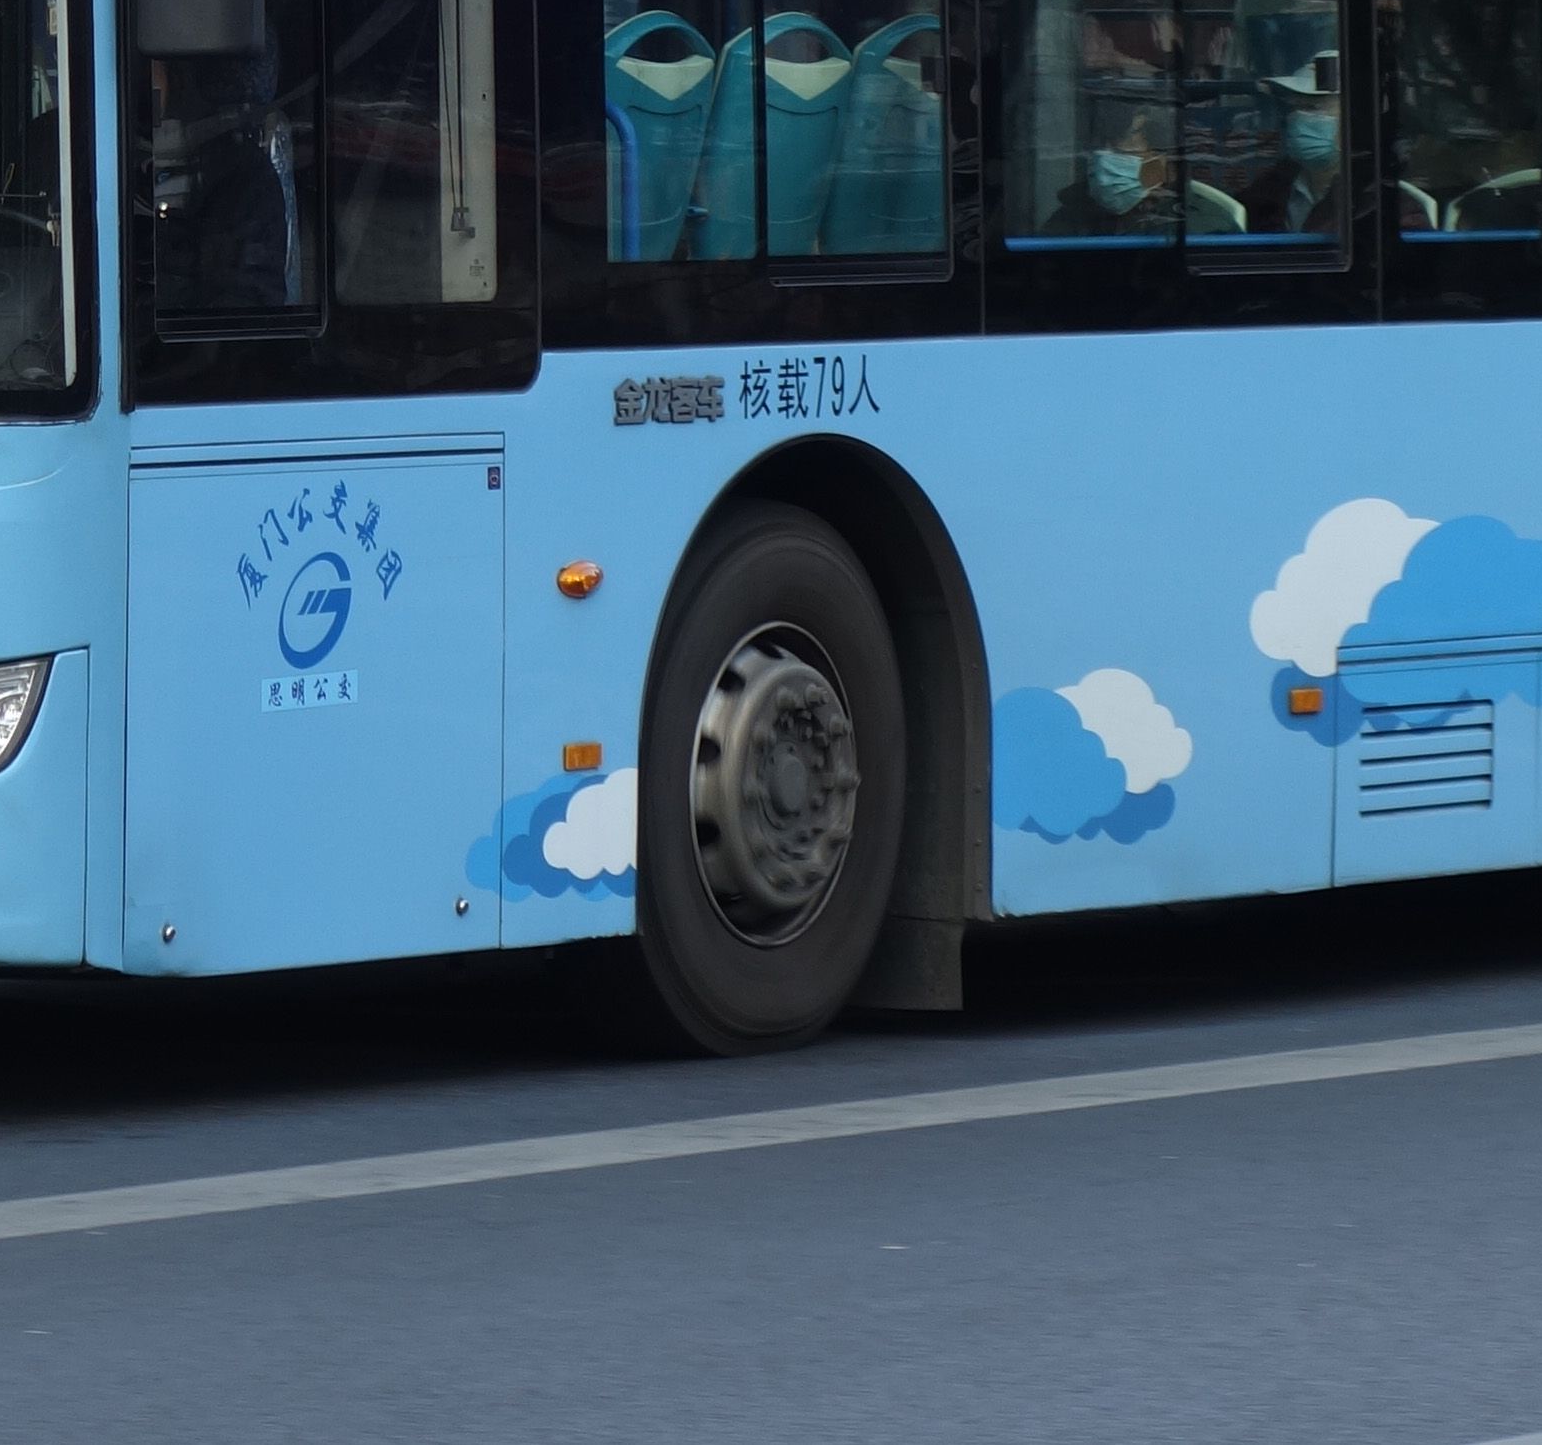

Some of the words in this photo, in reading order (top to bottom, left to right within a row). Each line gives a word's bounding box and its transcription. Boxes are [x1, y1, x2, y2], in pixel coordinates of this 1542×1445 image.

[614, 375, 725, 425] 金龙客车
[739, 354, 880, 419] 核载79人
[237, 479, 403, 611] 厦门公交集团
[268, 673, 351, 707] 思明公交
